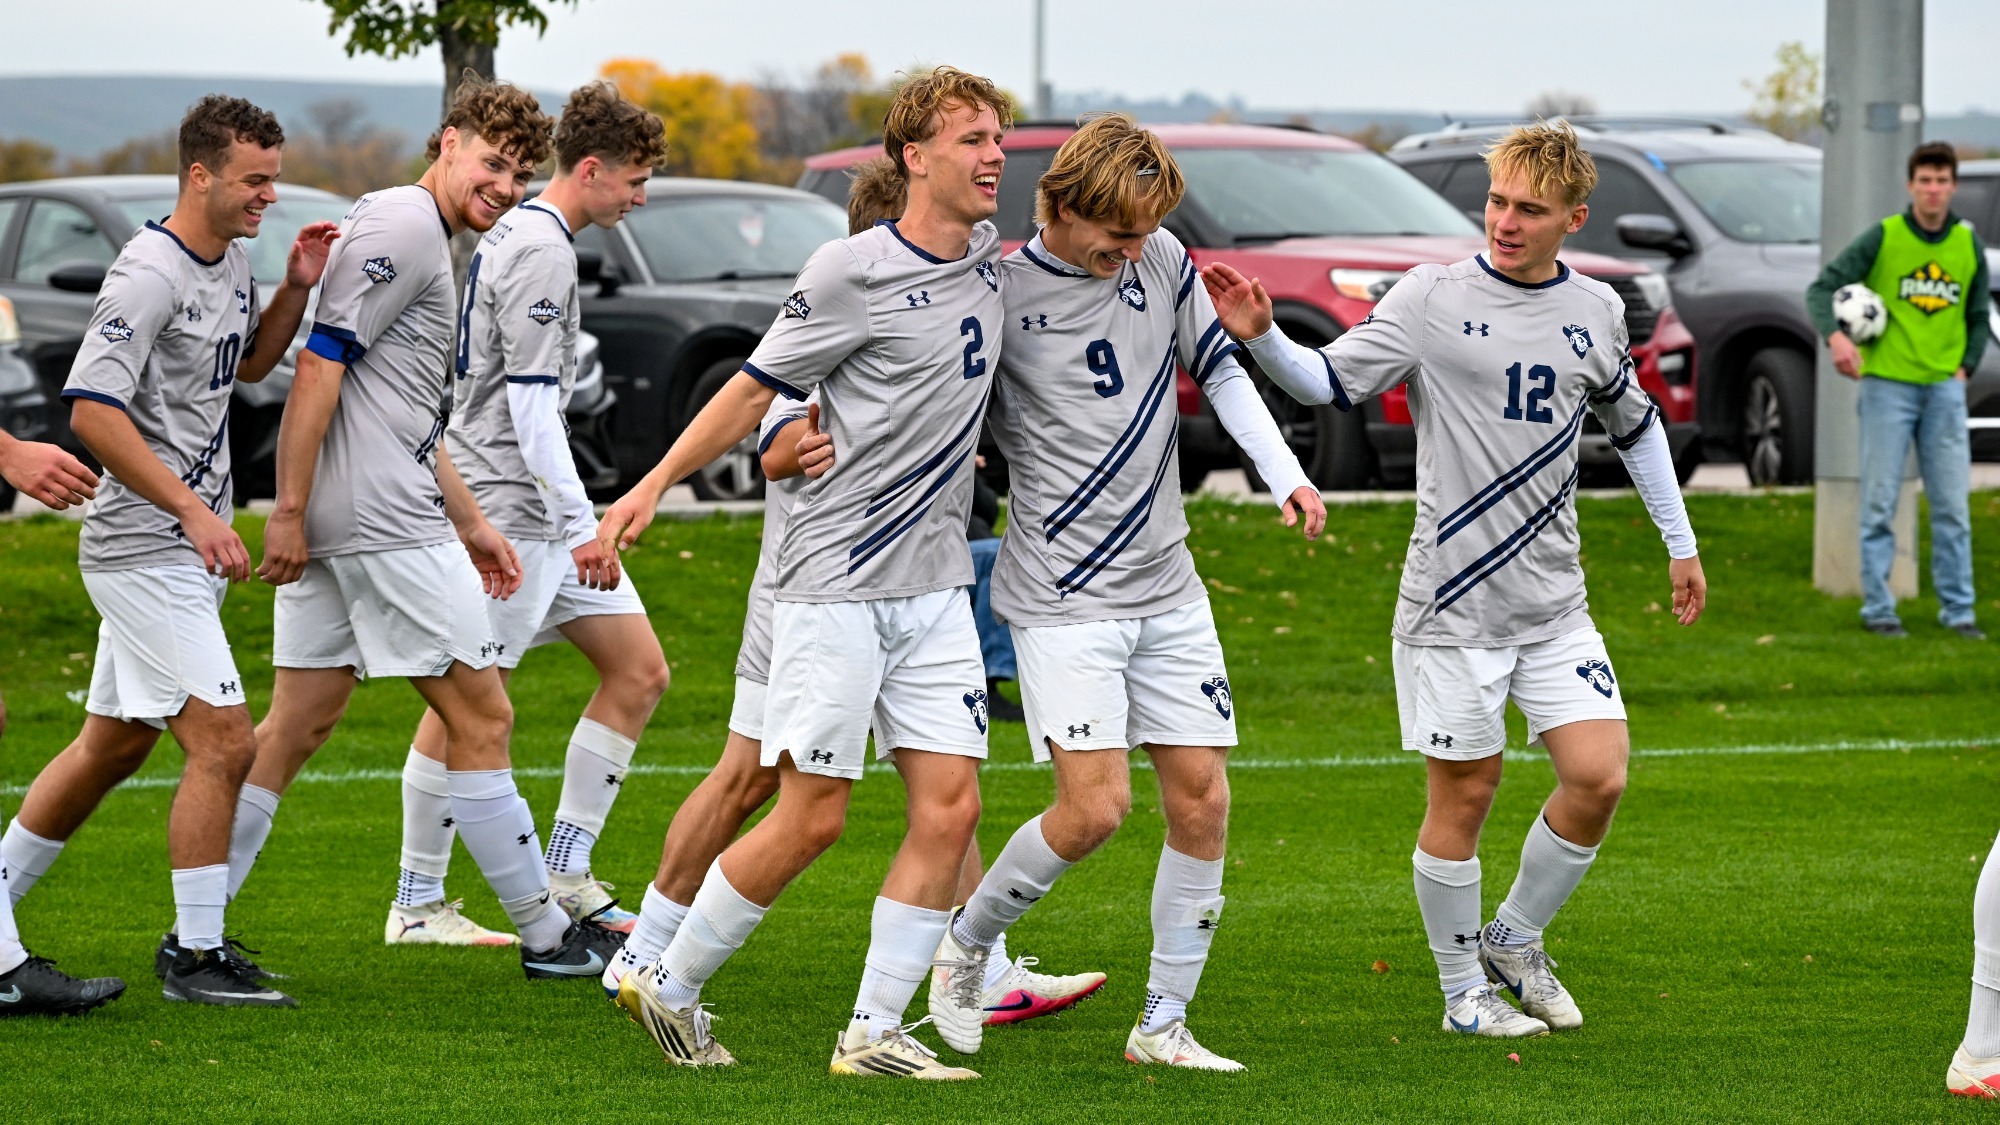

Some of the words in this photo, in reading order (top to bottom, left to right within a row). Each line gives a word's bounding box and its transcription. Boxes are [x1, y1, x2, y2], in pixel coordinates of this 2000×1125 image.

[364, 261, 395, 282] RMAC
[1901, 278, 1961, 304] RMAC
[102, 324, 132, 339] RMAC
[530, 307, 559, 318] RMAC
[210, 332, 241, 391] 10
[960, 315, 986, 380] 2
[1086, 338, 1125, 398] 9
[1504, 361, 1557, 424] 12
